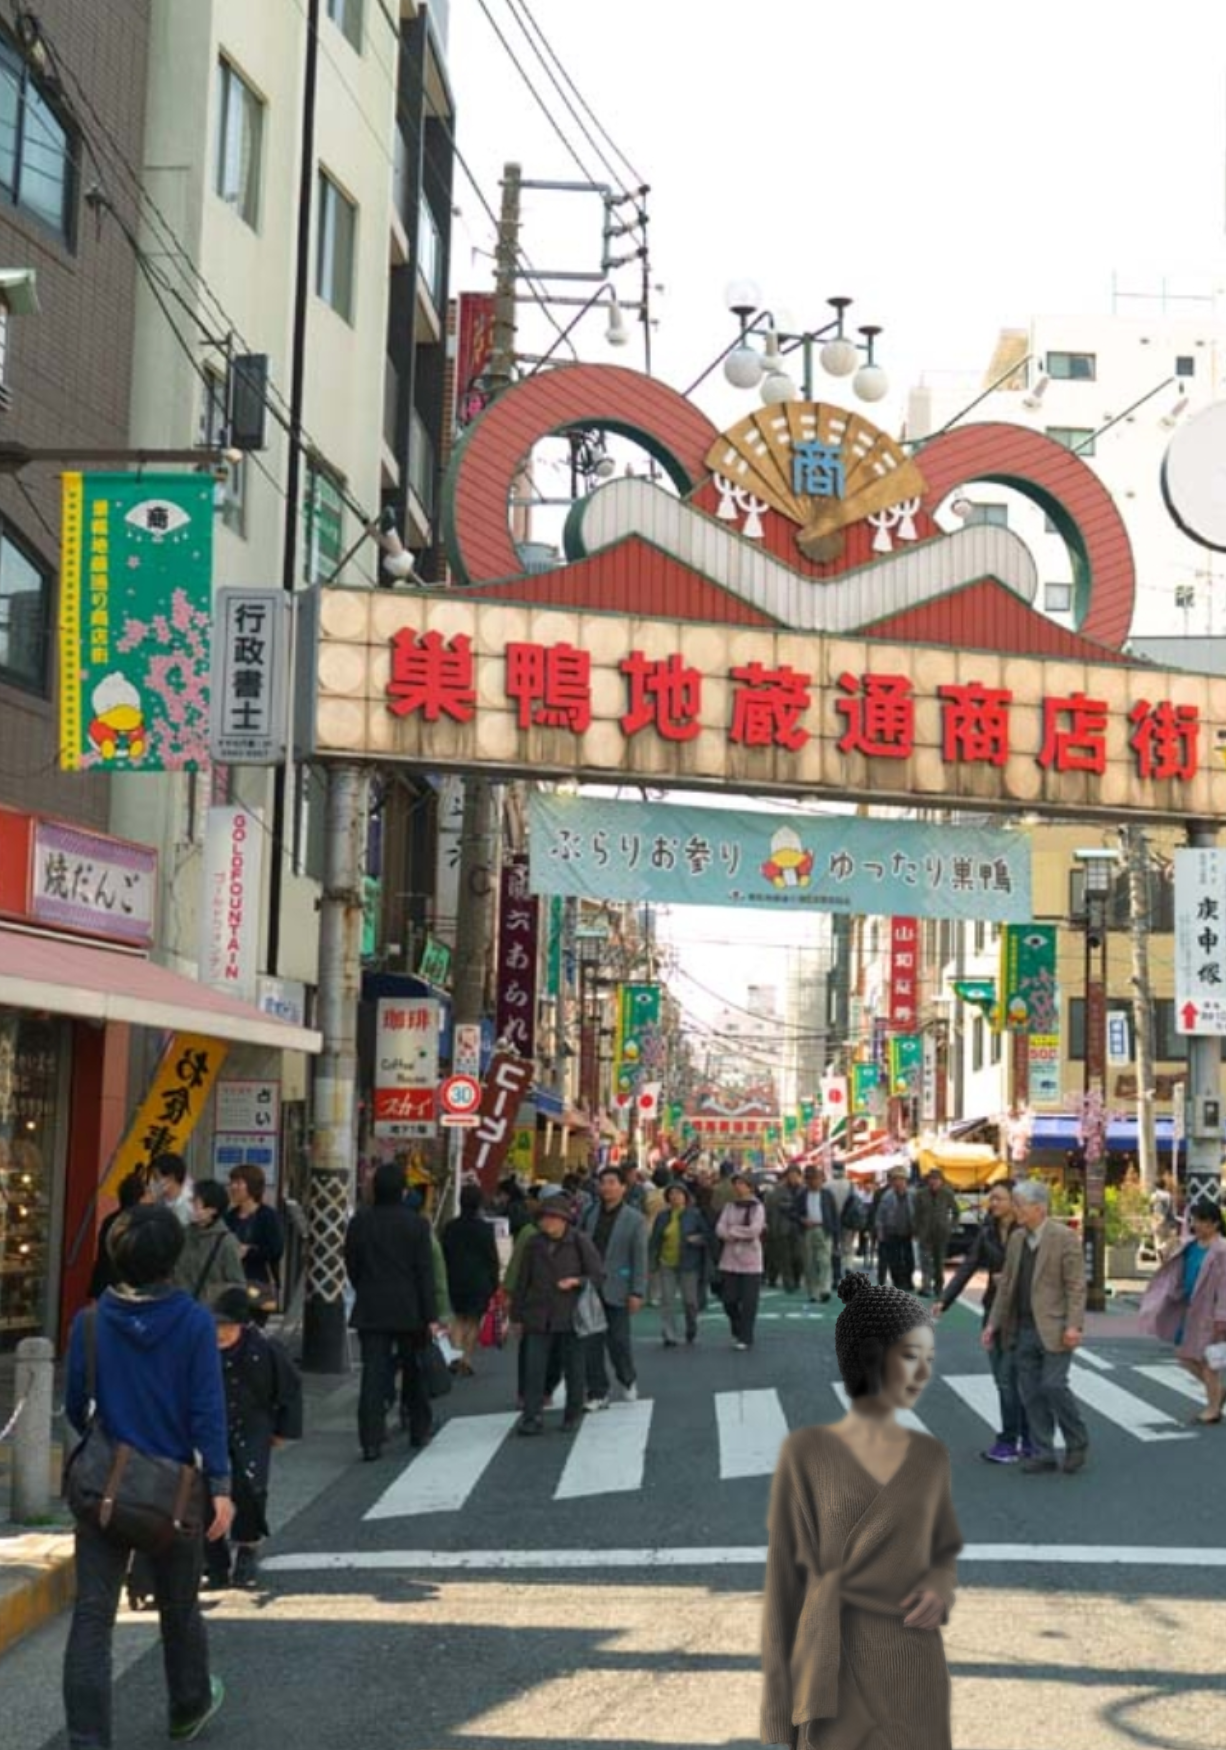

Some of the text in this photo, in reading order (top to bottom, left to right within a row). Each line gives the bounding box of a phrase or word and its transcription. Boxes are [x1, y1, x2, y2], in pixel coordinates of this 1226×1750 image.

[795, 440, 845, 500] 商
[231, 603, 266, 731] 行政書士
[385, 627, 1199, 782] 巣鴨地蔵通商店街
[44, 851, 140, 914] 焼だんご
[550, 830, 740, 876] ぶらりお参り
[829, 852, 1012, 895] ゆったり巣鴨
[225, 814, 246, 980] GOLDFOUNTAIN
[451, 1087, 472, 1105] 30
